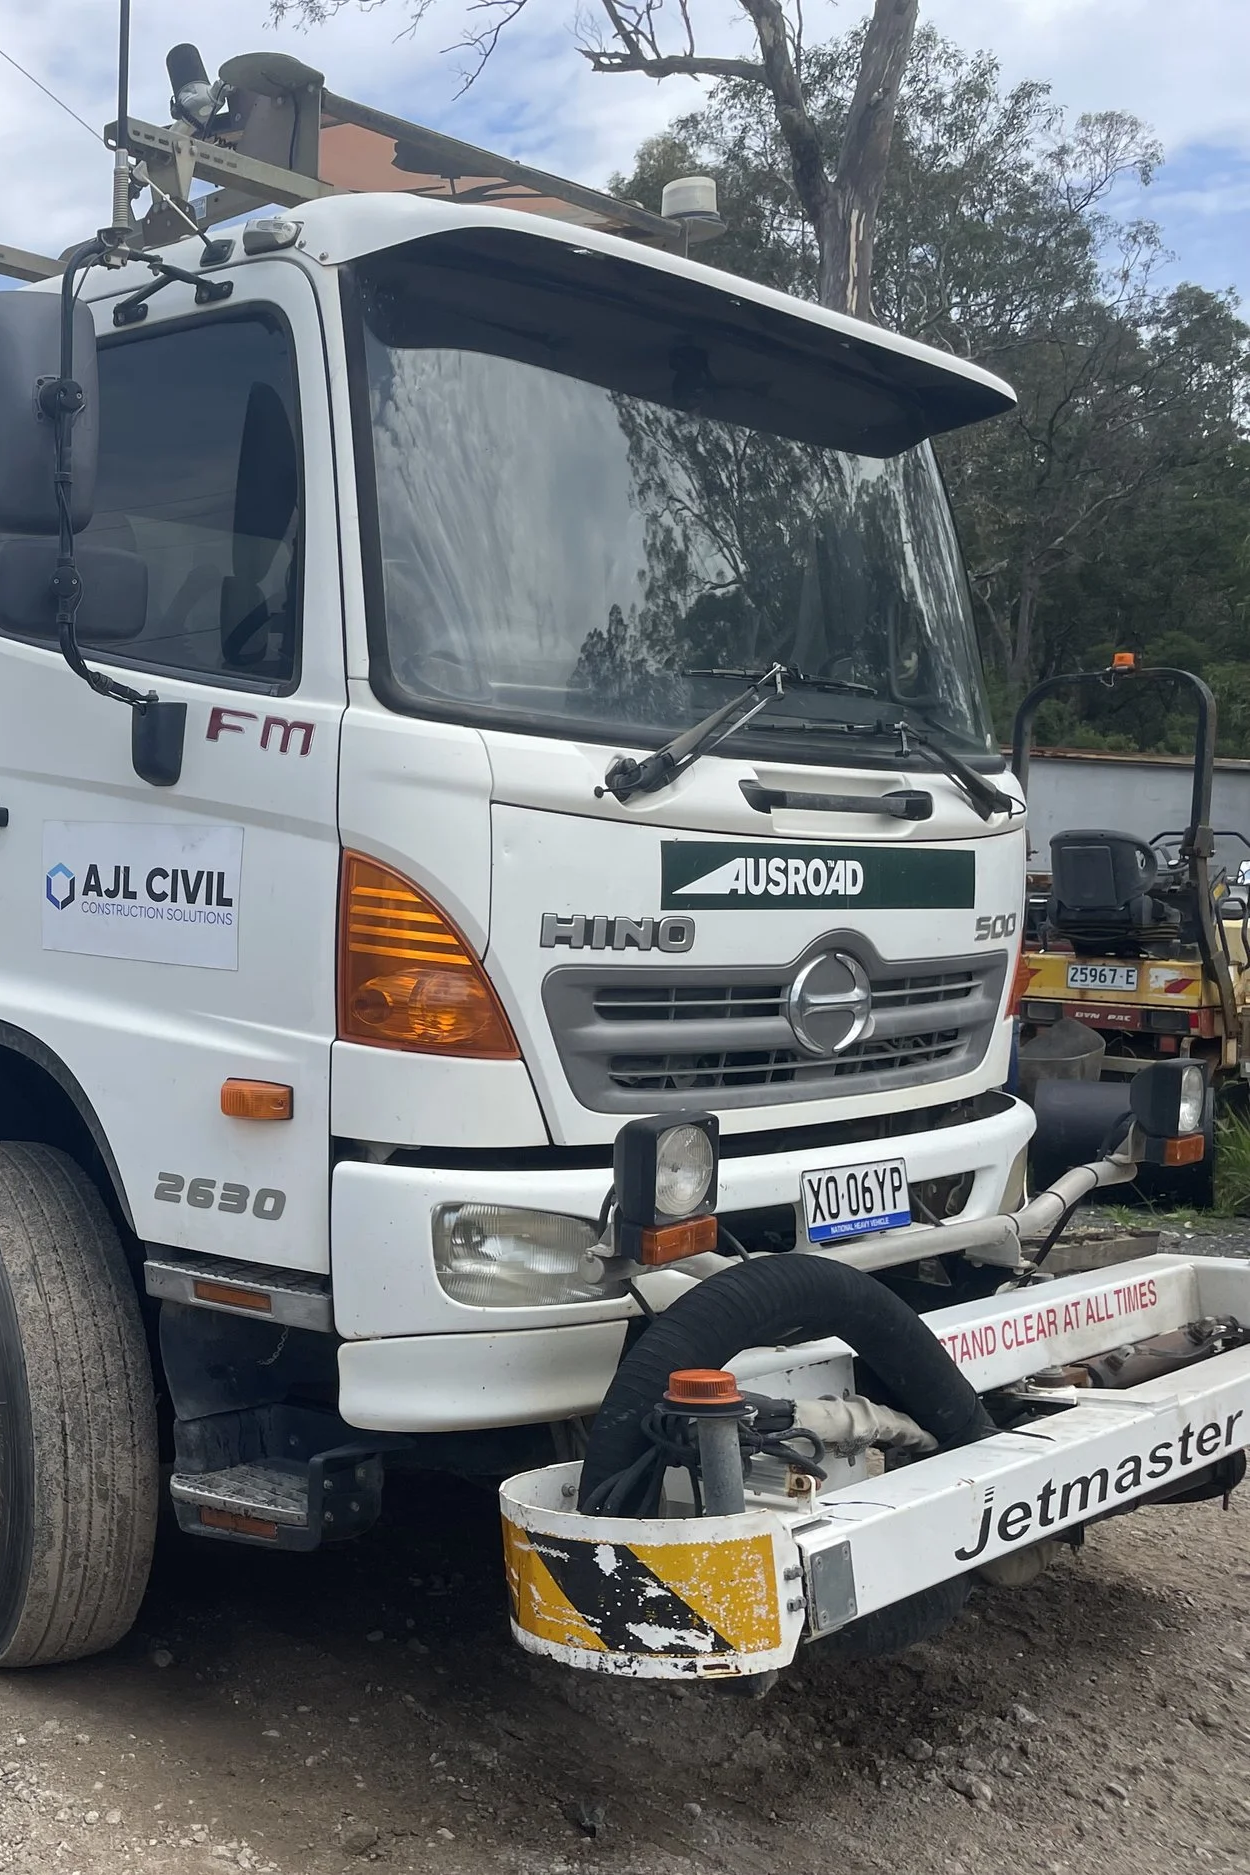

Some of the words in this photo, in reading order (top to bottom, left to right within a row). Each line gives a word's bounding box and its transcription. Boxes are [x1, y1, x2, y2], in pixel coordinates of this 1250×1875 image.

[81, 863, 138, 900] AJL
[145, 867, 233, 908] CIVIL
[672, 857, 864, 896] AUSROAD
[81, 901, 164, 921] CONSTRUCTION
[166, 908, 233, 926] SOLUTIONS
[540, 912, 696, 953] HINO
[973, 912, 1017, 941] 500
[154, 1171, 287, 1221] 2630
[830, 1222, 854, 1234] NATIONAL
[854, 1220, 870, 1230] HEAVY
[870, 1217, 890, 1227] VEHICLE
[1001, 1307, 1059, 1350] CLEAR
[1063, 1301, 1081, 1333] AT
[1085, 1294, 1114, 1326] ALL
[1113, 1279, 1158, 1316] TIMES
[954, 1409, 1244, 1561] jetmaster
